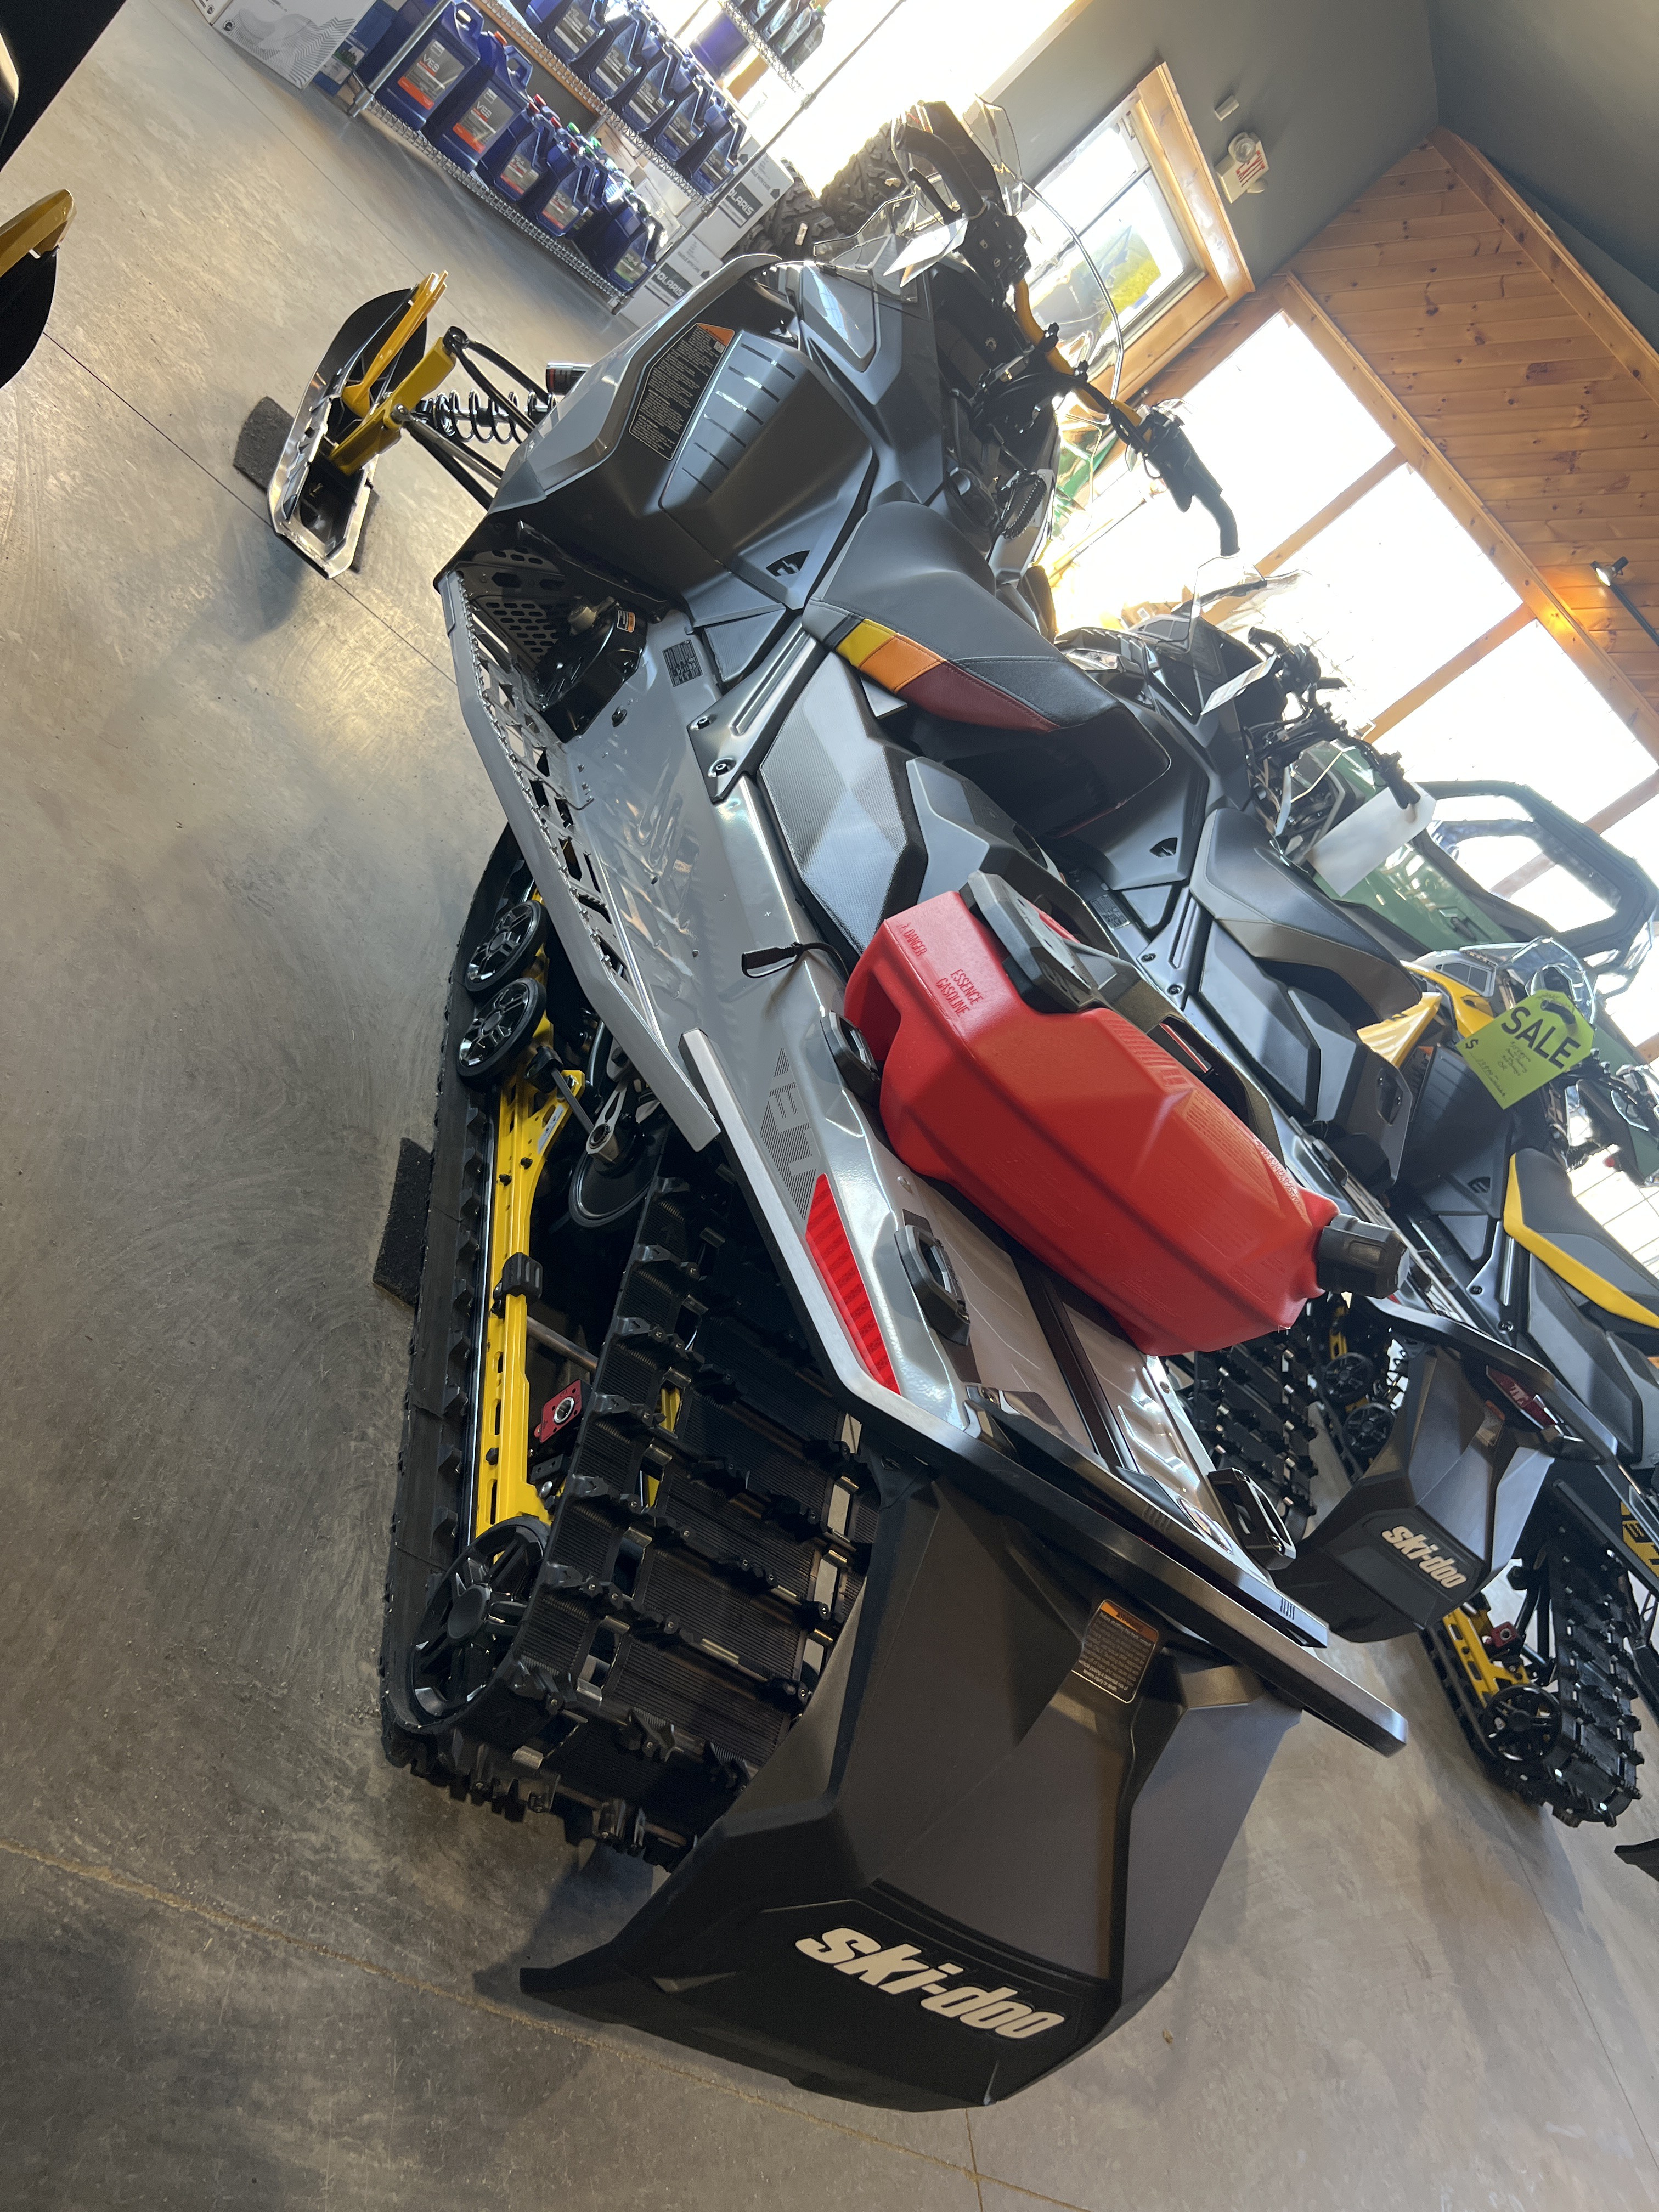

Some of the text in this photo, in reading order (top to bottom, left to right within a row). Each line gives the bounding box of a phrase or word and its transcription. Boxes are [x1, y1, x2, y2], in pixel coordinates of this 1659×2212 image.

[422, 53, 441, 73] VES
[476, 100, 493, 119] VES
[727, 187, 755, 216] OLARIS
[902, 927, 928, 957] DANGER
[934, 975, 970, 1017] GASOLINE
[949, 967, 984, 1006] ESSENCE
[1465, 1039, 1478, 1049] $
[1501, 1006, 1582, 1070] SALE
